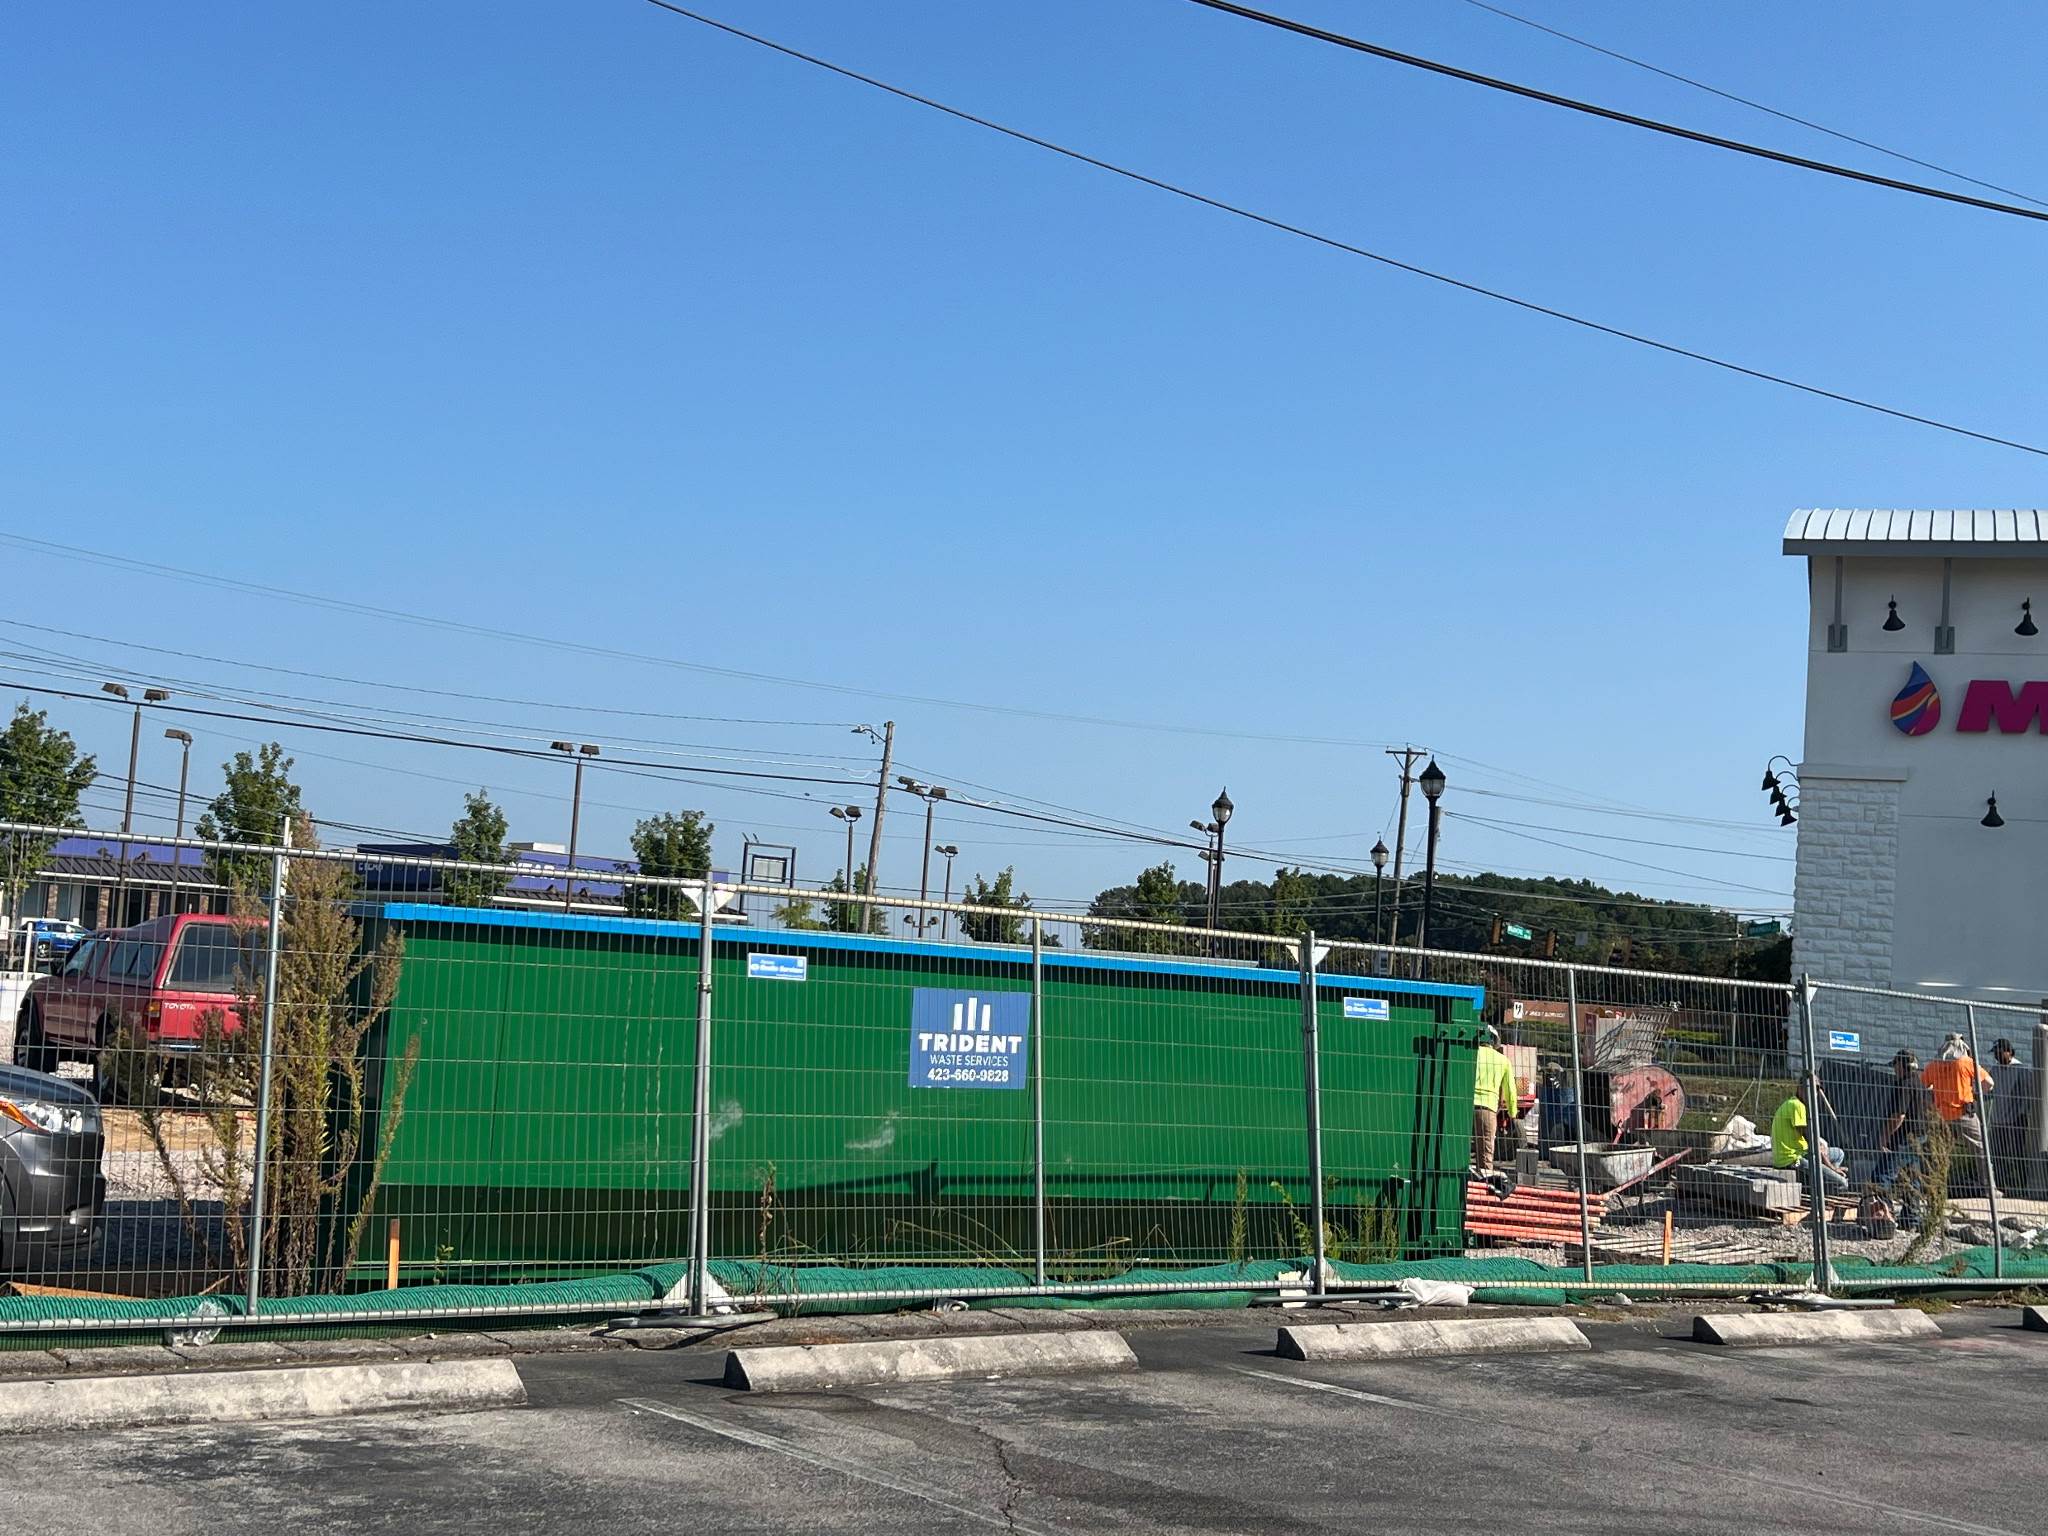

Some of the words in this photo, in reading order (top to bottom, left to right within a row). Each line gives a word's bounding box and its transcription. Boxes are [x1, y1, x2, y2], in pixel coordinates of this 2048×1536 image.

[1956, 680, 2048, 735] M
[164, 1002, 196, 1010] TOYOTA
[919, 1033, 1022, 1053] TRIDENT
[930, 1054, 963, 1066] WASTE
[964, 1055, 1009, 1067] SERVICES
[927, 1067, 1009, 1082] 423-660-9828
